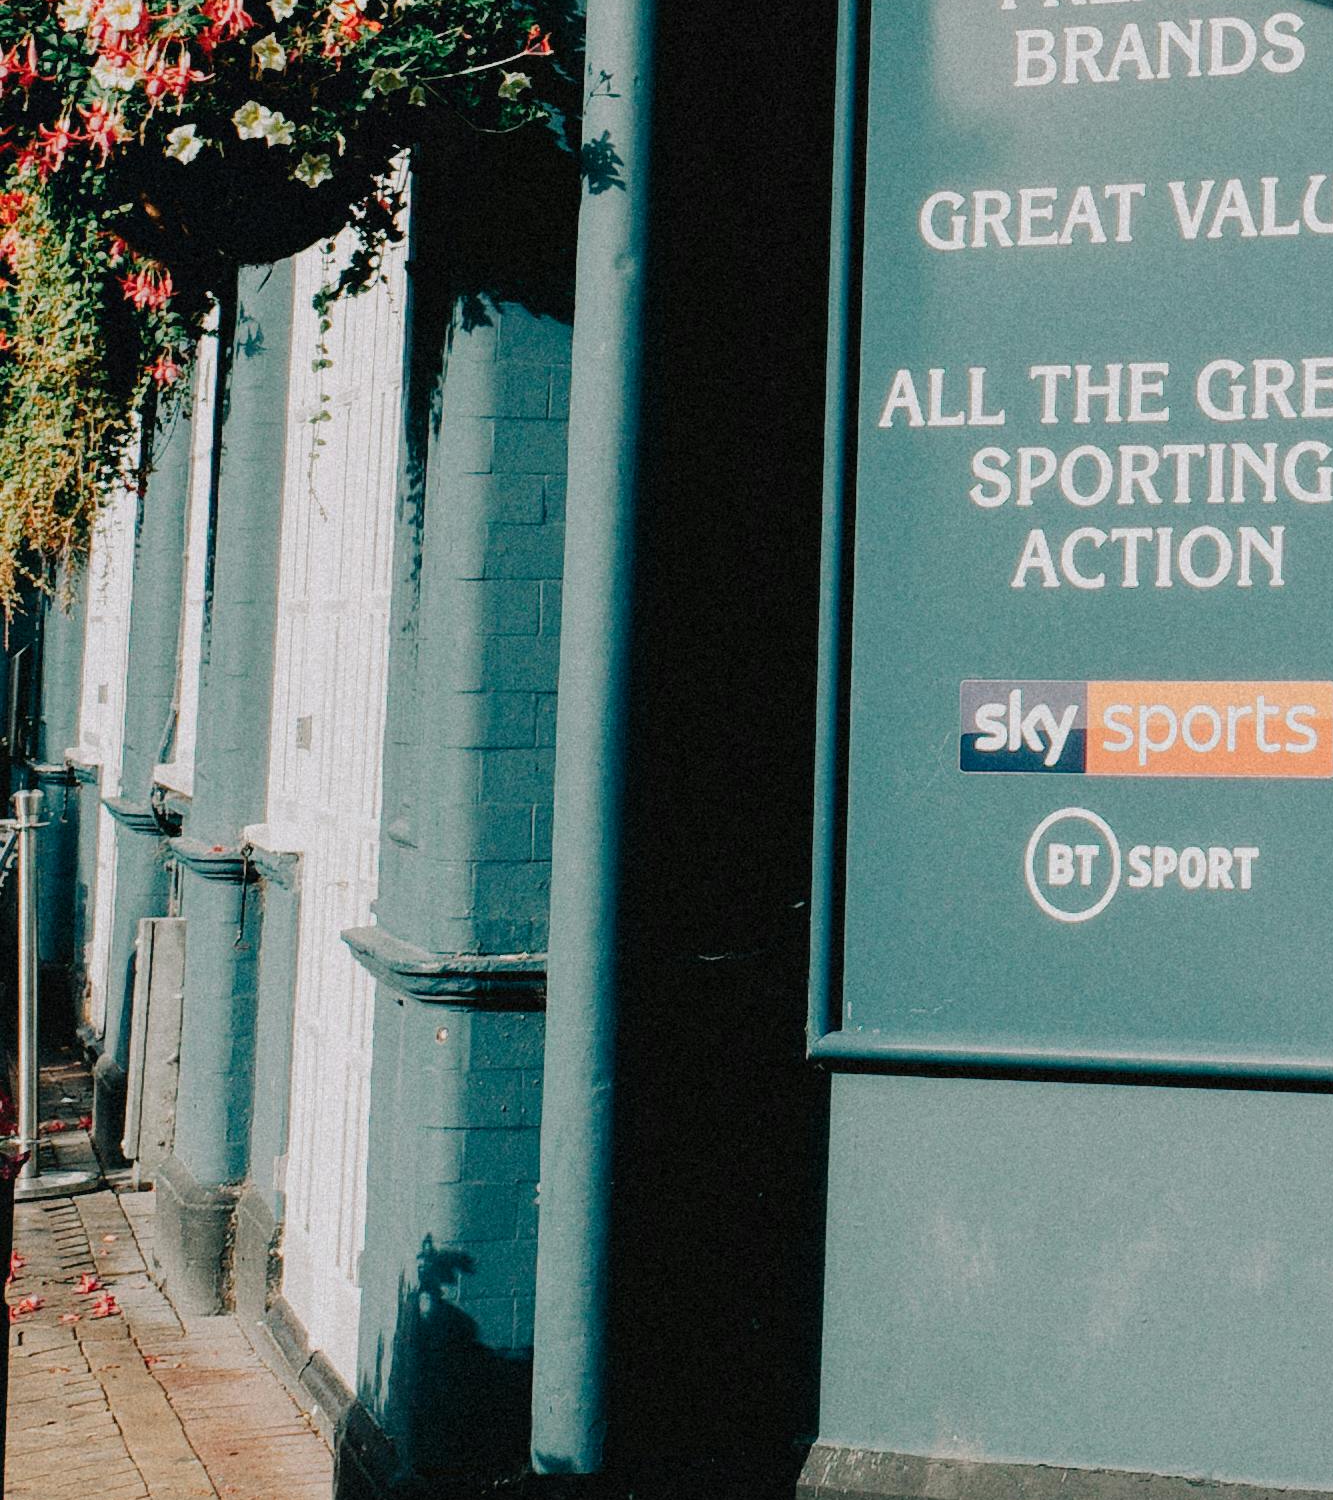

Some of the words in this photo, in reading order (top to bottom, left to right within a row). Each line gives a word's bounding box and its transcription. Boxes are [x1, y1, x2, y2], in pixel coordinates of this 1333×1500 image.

[1014, 12, 1308, 88] BRANDS
[919, 181, 1146, 251] GREAT
[878, 366, 1006, 430] ALL
[1030, 362, 1170, 427] THE
[1010, 525, 1287, 591] ACTION
[974, 687, 1080, 767] sky
[1102, 691, 1320, 767] sports
[1048, 846, 1099, 888] BT
[1128, 844, 1260, 891] SPORT
